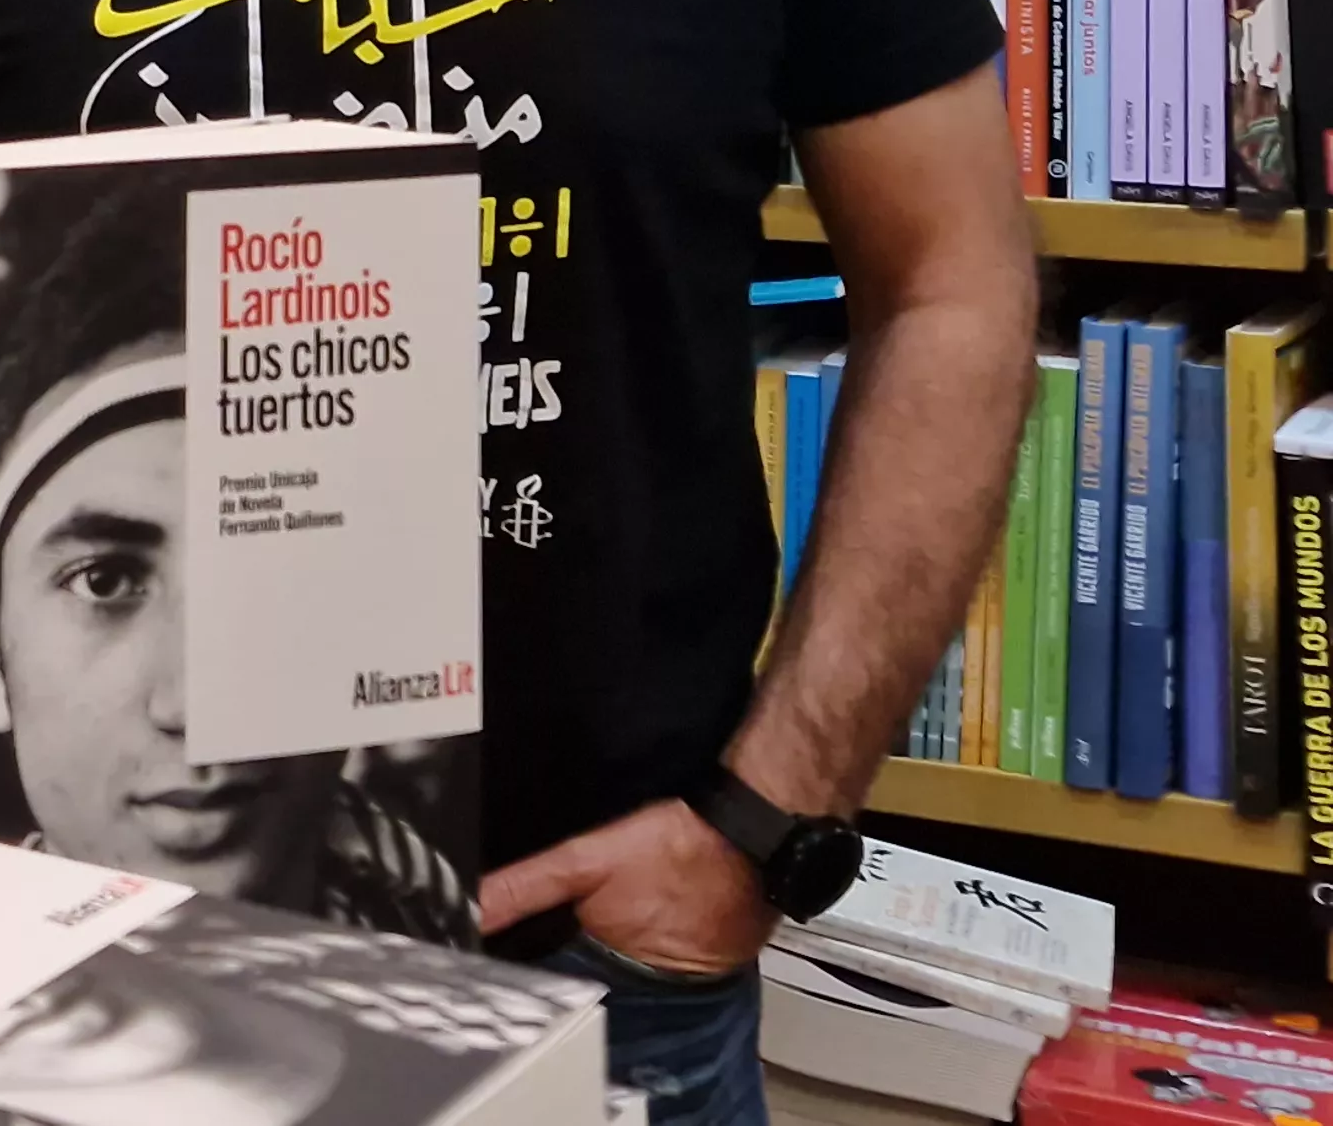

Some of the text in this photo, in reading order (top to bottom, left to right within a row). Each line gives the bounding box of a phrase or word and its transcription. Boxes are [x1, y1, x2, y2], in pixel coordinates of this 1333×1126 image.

[1080, 22, 1099, 76] juntos
[219, 216, 323, 274] Rocío
[219, 269, 392, 330] Lardinois
[219, 323, 412, 385] Los chicos
[216, 383, 356, 438] tuertos
[219, 469, 320, 494] Premio Unicaja
[219, 493, 285, 515] de Novela
[218, 515, 281, 538] Fernando
[1077, 498, 1100, 605] VICENTE GARRIDO
[1122, 503, 1149, 611] VICENTE GARRIDO
[1291, 494, 1333, 865] LA GUERRA DE LOS MUNDOS
